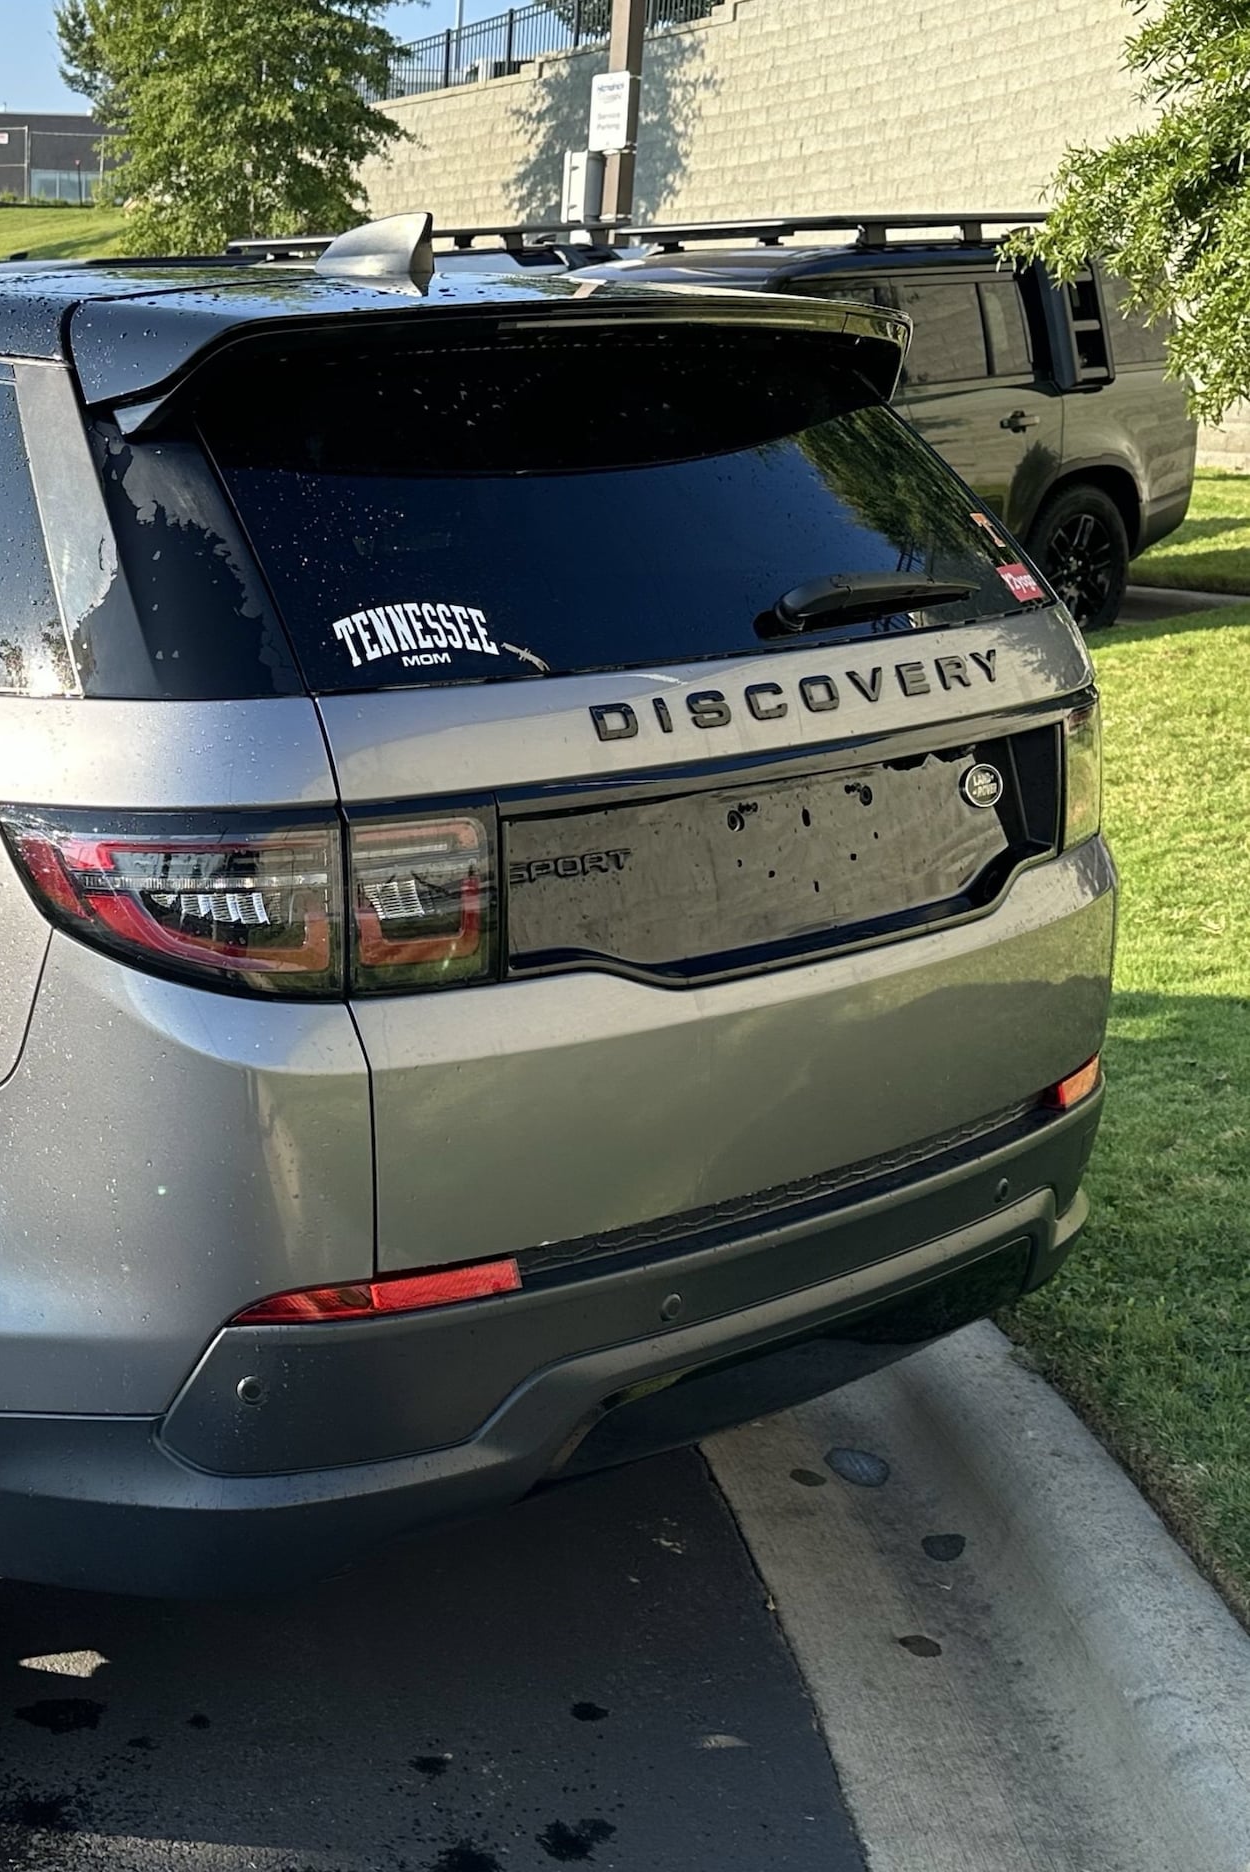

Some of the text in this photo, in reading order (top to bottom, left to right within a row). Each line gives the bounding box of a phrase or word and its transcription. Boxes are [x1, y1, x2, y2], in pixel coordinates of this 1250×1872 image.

[332, 602, 500, 668] TENNESSEE
[401, 652, 452, 668] MOM
[589, 648, 997, 742] DISCOVERY
[509, 847, 633, 885] SPORT
